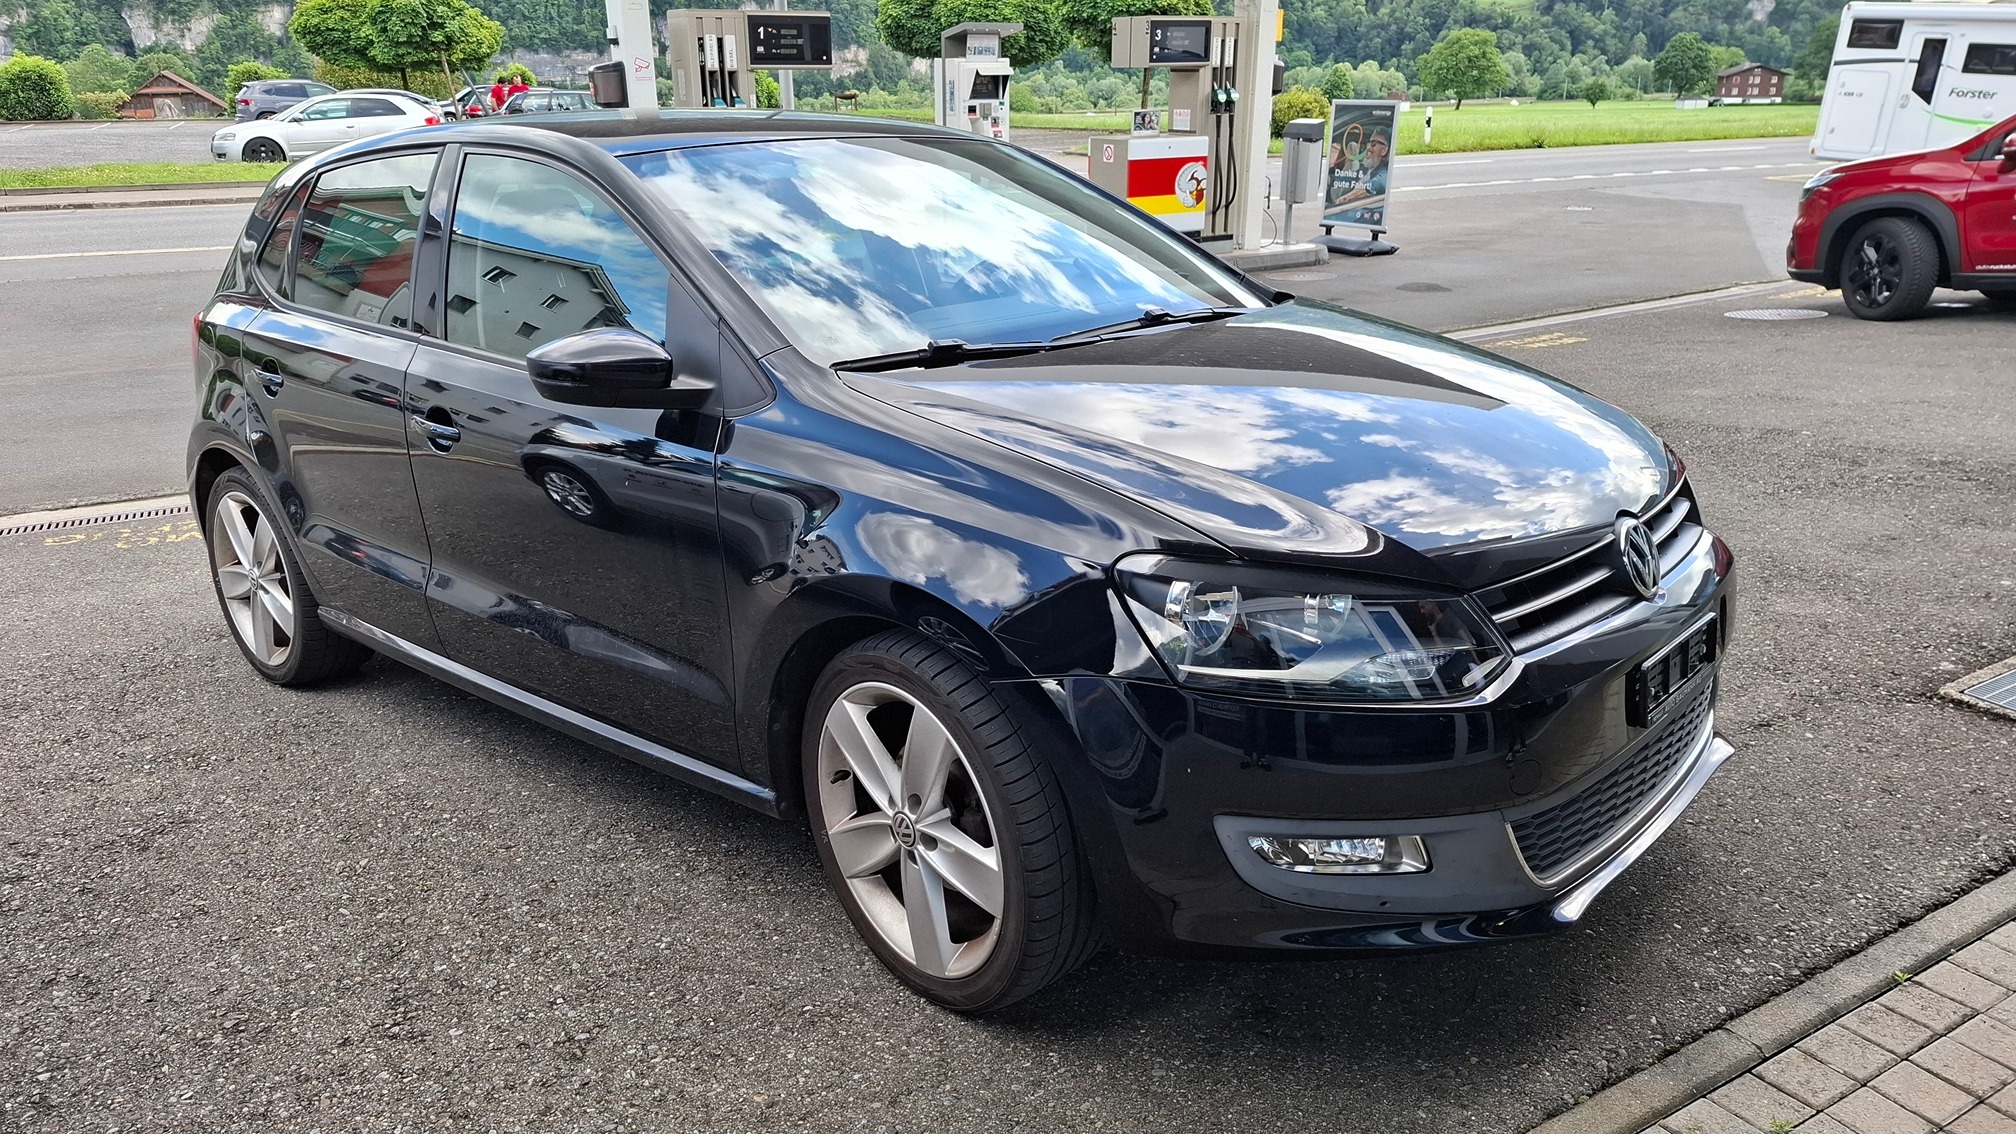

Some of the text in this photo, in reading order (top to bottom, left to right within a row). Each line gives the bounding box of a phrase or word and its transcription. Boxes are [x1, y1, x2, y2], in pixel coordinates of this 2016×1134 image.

[757, 26, 764, 40] 1
[1155, 29, 1162, 41] 3
[1948, 87, 1998, 100] Forster
[1334, 168, 1364, 178] Danke &
[1333, 180, 1372, 190] gute Fahrt!
